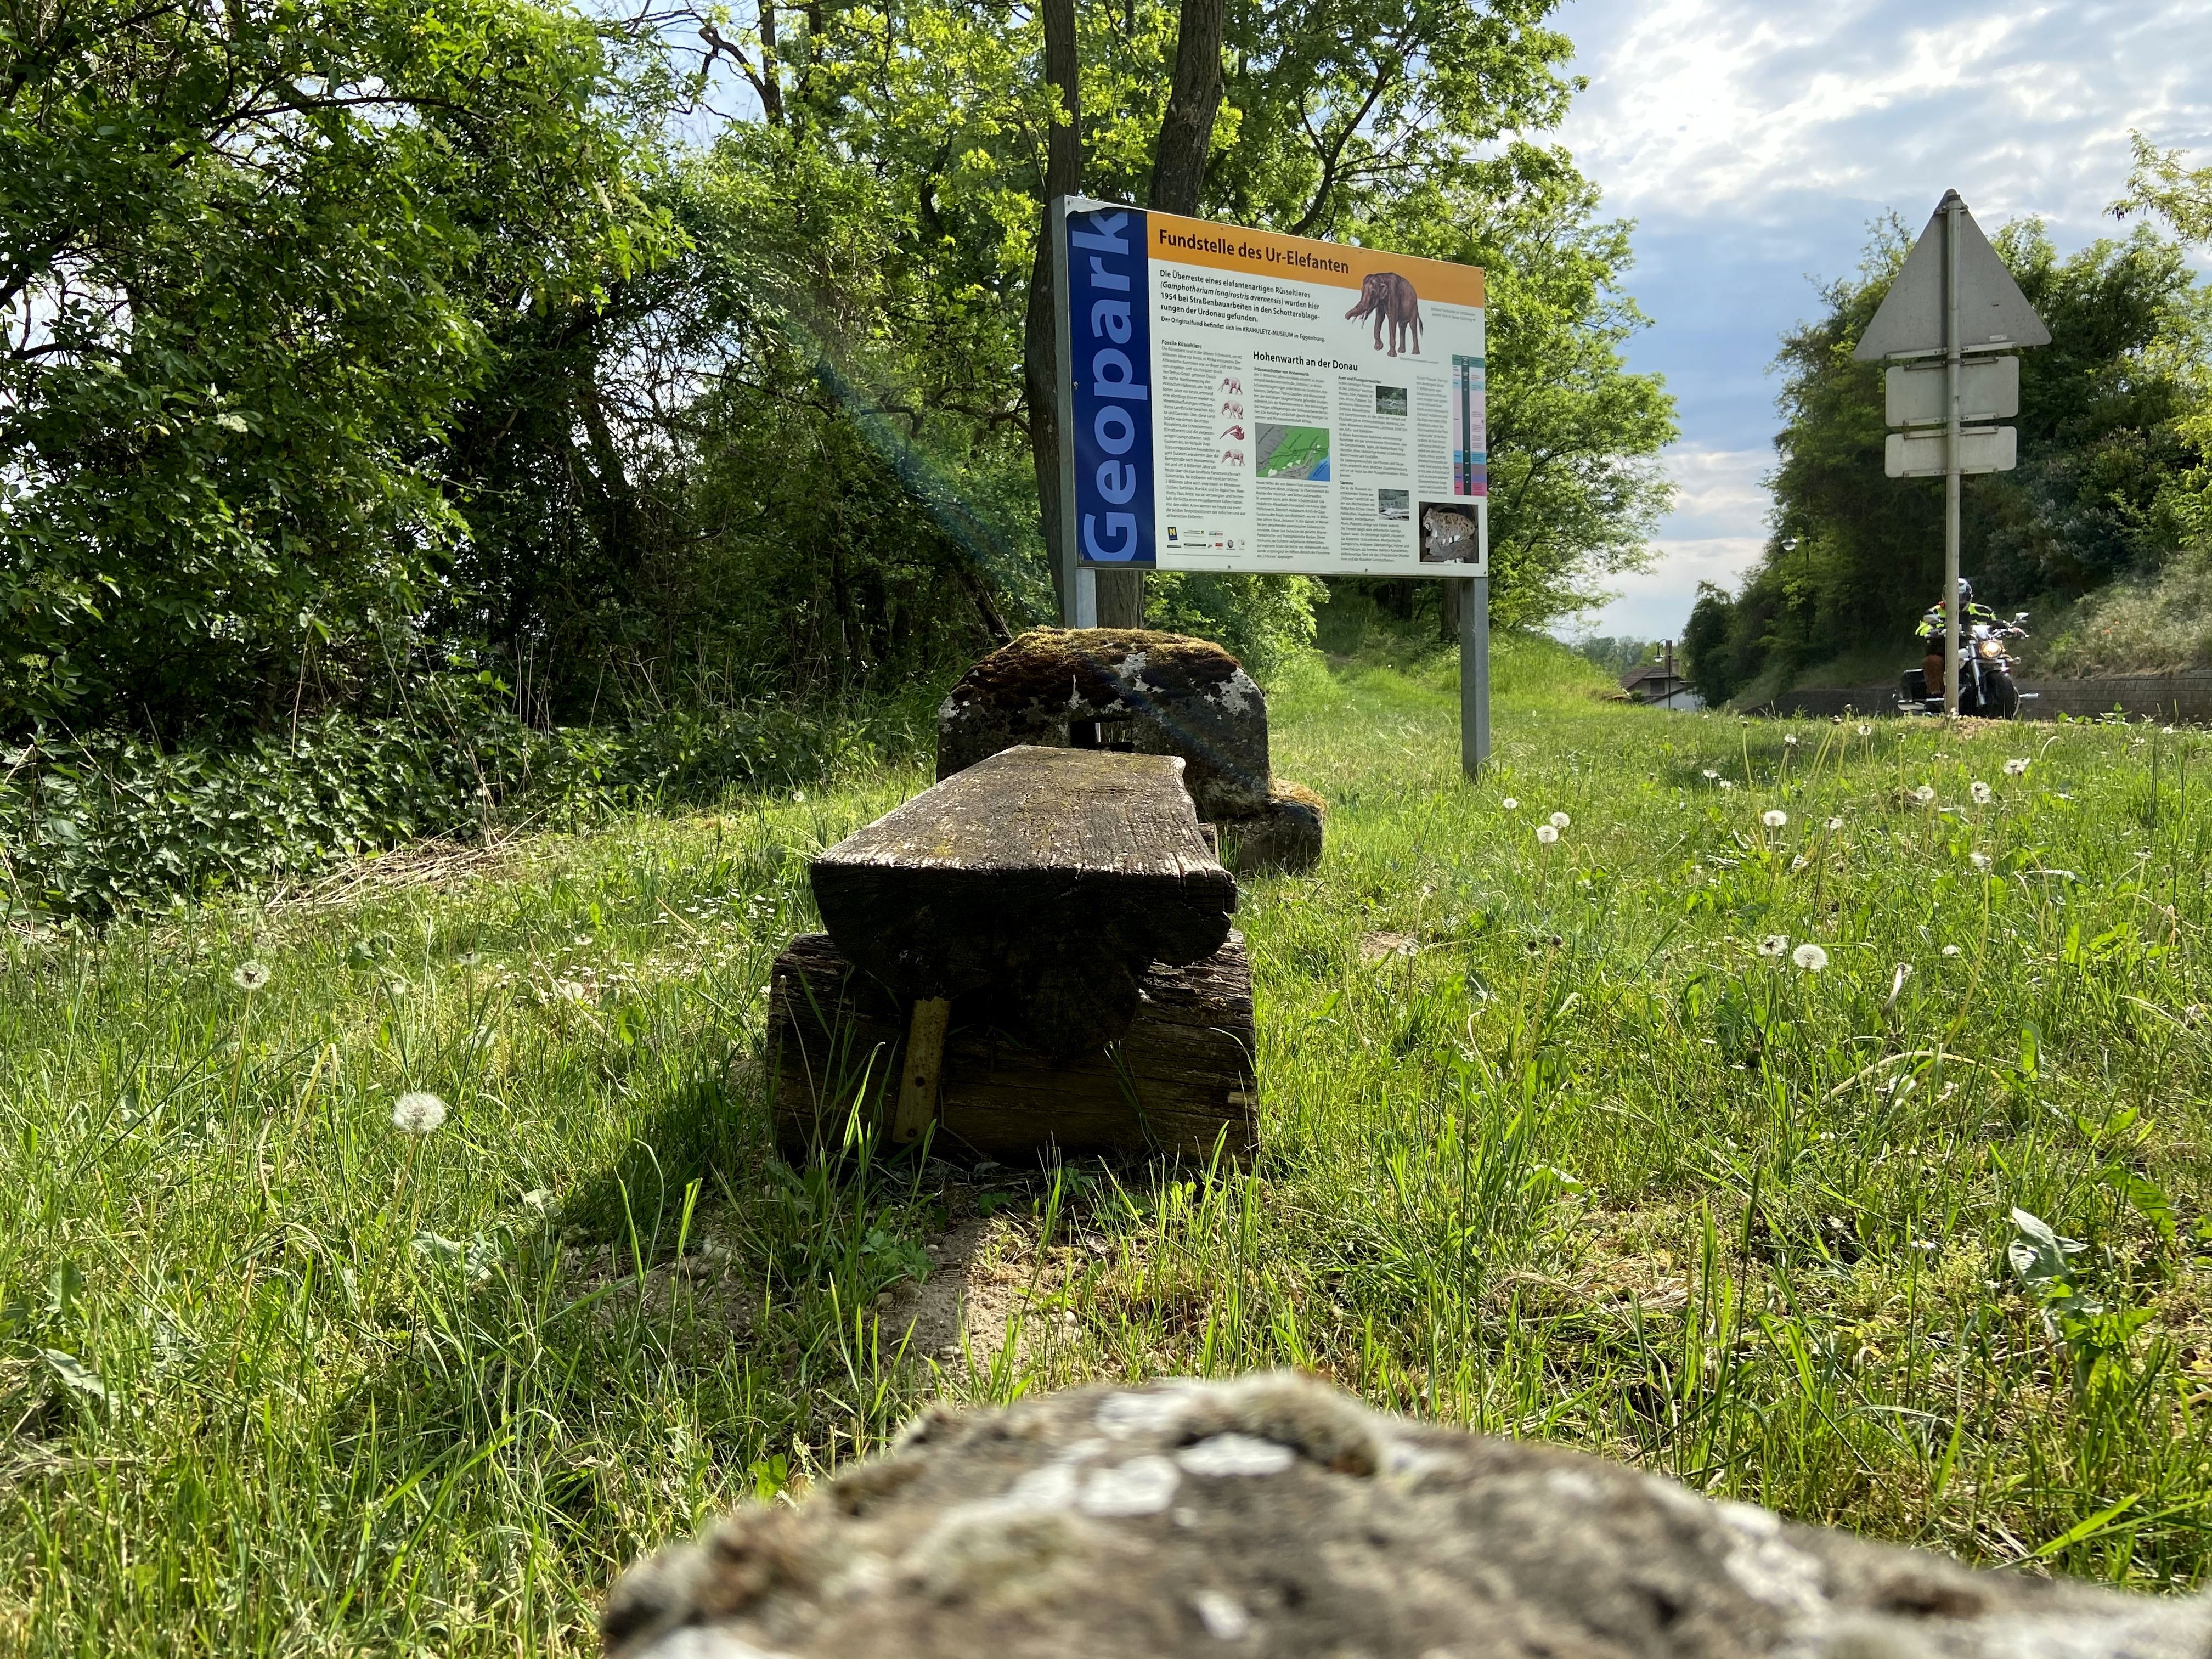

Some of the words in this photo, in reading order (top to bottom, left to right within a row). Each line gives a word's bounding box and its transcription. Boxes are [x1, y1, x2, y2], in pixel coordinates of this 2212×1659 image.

[1160, 229, 1234, 256] Fundstelle
[1238, 242, 1262, 260] des
[1266, 247, 1348, 274] Ur-Elefanten
[1160, 269, 1171, 278] Die
[1172, 270, 1204, 283] Überreste
[1205, 276, 1222, 285] eines
[1223, 279, 1274, 294] elefantenartigen
[1275, 286, 1311, 298] Rüsseltieres
[1160, 281, 1214, 295] (Gomphotherium
[1215, 288, 1249, 300] longirostris
[1250, 295, 1284, 306] avernensis)
[1308, 301, 1320, 310] hier
[1161, 292, 1177, 301] 1954
[1178, 294, 1188, 302] bei
[1189, 296, 1252, 311] Straßenbauarbeiten
[1260, 306, 1272, 314] den
[1273, 307, 1321, 321] Schotterablage-
[1161, 304, 1184, 313] rungen
[1186, 306, 1197, 314] der
[1198, 308, 1226, 318] Urdonau
[1226, 312, 1259, 322] gefunden.
[1171, 317, 1203, 326] Originalfund
[1204, 321, 1224, 329] befindet
[1242, 326, 1294, 338] KRAHULETZ-MUSEUM
[1253, 351, 1304, 365] Hohenwarth
[1317, 358, 1331, 368] der
[1333, 360, 1358, 371] Donau
[1072, 211, 1147, 561] Geopark
